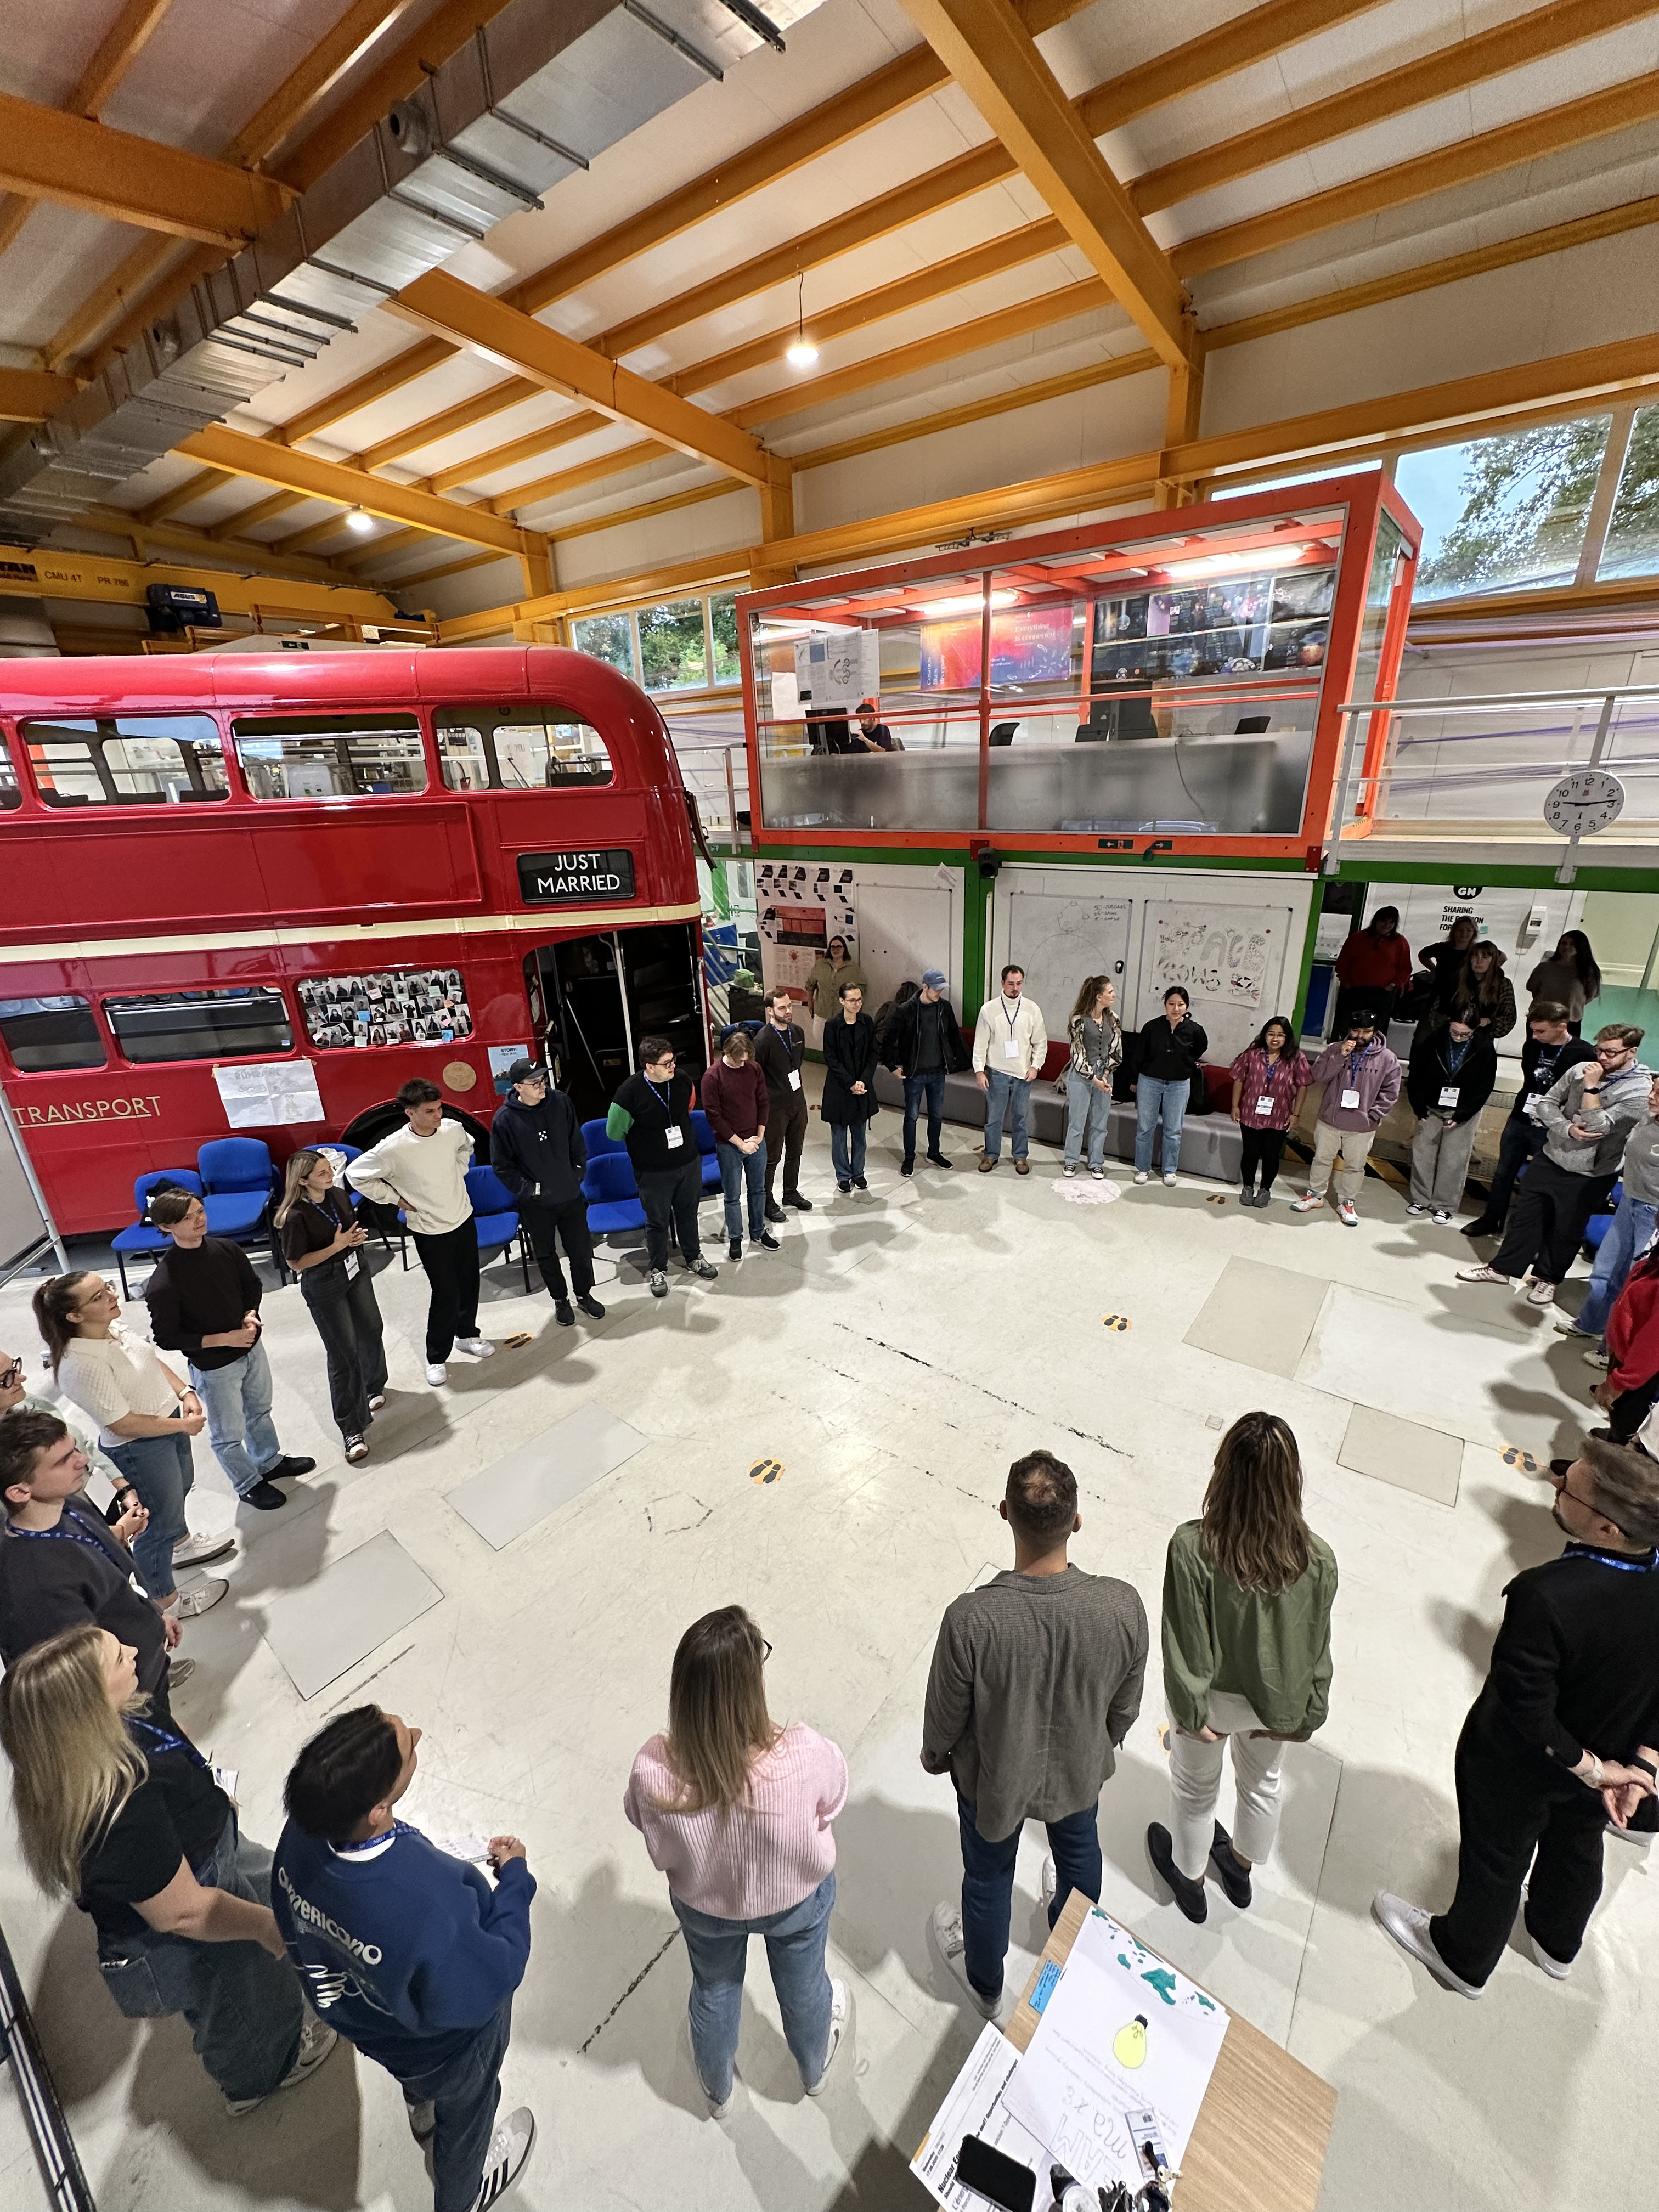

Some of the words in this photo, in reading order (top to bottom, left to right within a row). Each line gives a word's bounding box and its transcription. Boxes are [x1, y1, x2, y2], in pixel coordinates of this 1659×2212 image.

[44, 571, 67, 581] CMU
[98, 577, 111, 585] PR
[1015, 623, 1049, 633] Everything
[1022, 630, 1056, 641] connected
[554, 853, 600, 871] JUST
[537, 874, 620, 894] MARRIED
[1458, 887, 1476, 896] GN
[1443, 906, 1474, 914] SHARING
[12, 1095, 161, 1124] TRANSPORT
[937, 2162, 955, 2193] Nuclear
[944, 2179, 955, 2199] Should
